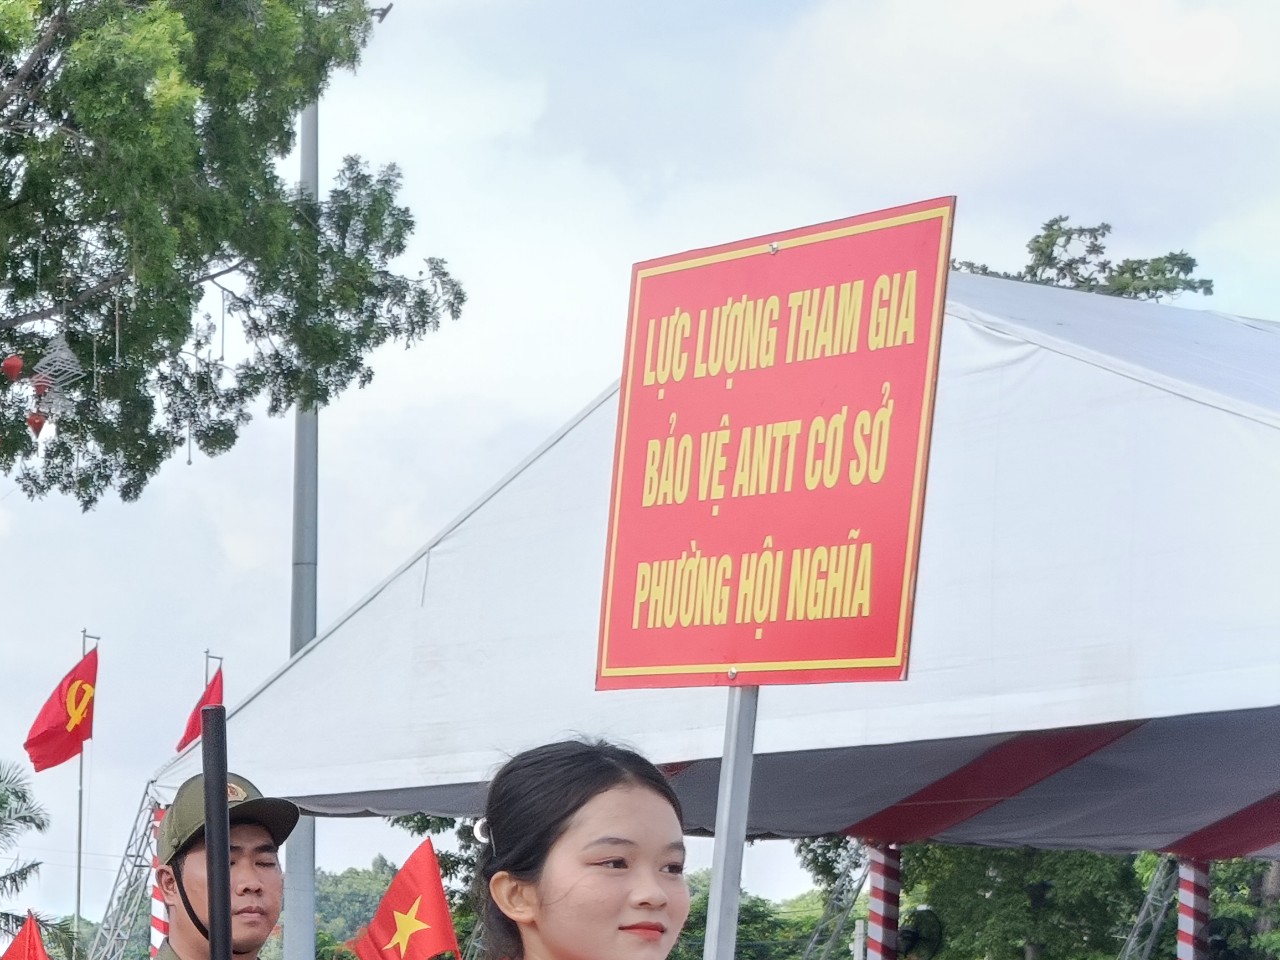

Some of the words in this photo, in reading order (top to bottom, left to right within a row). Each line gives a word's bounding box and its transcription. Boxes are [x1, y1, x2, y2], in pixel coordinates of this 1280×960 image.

[642, 306, 691, 400] LỰC
[693, 294, 780, 390] LƯỢNG
[785, 279, 864, 364] THAM
[868, 269, 918, 351] GIA
[641, 411, 692, 507] BẢO
[698, 413, 731, 516] VỆ
[732, 420, 802, 498] ANTT
[805, 406, 848, 490] CƠ
[849, 382, 894, 486] SỞ
[632, 539, 733, 630] PHƯỜNG
[735, 535, 783, 640] HỘI
[786, 528, 873, 621] NGHĨA
